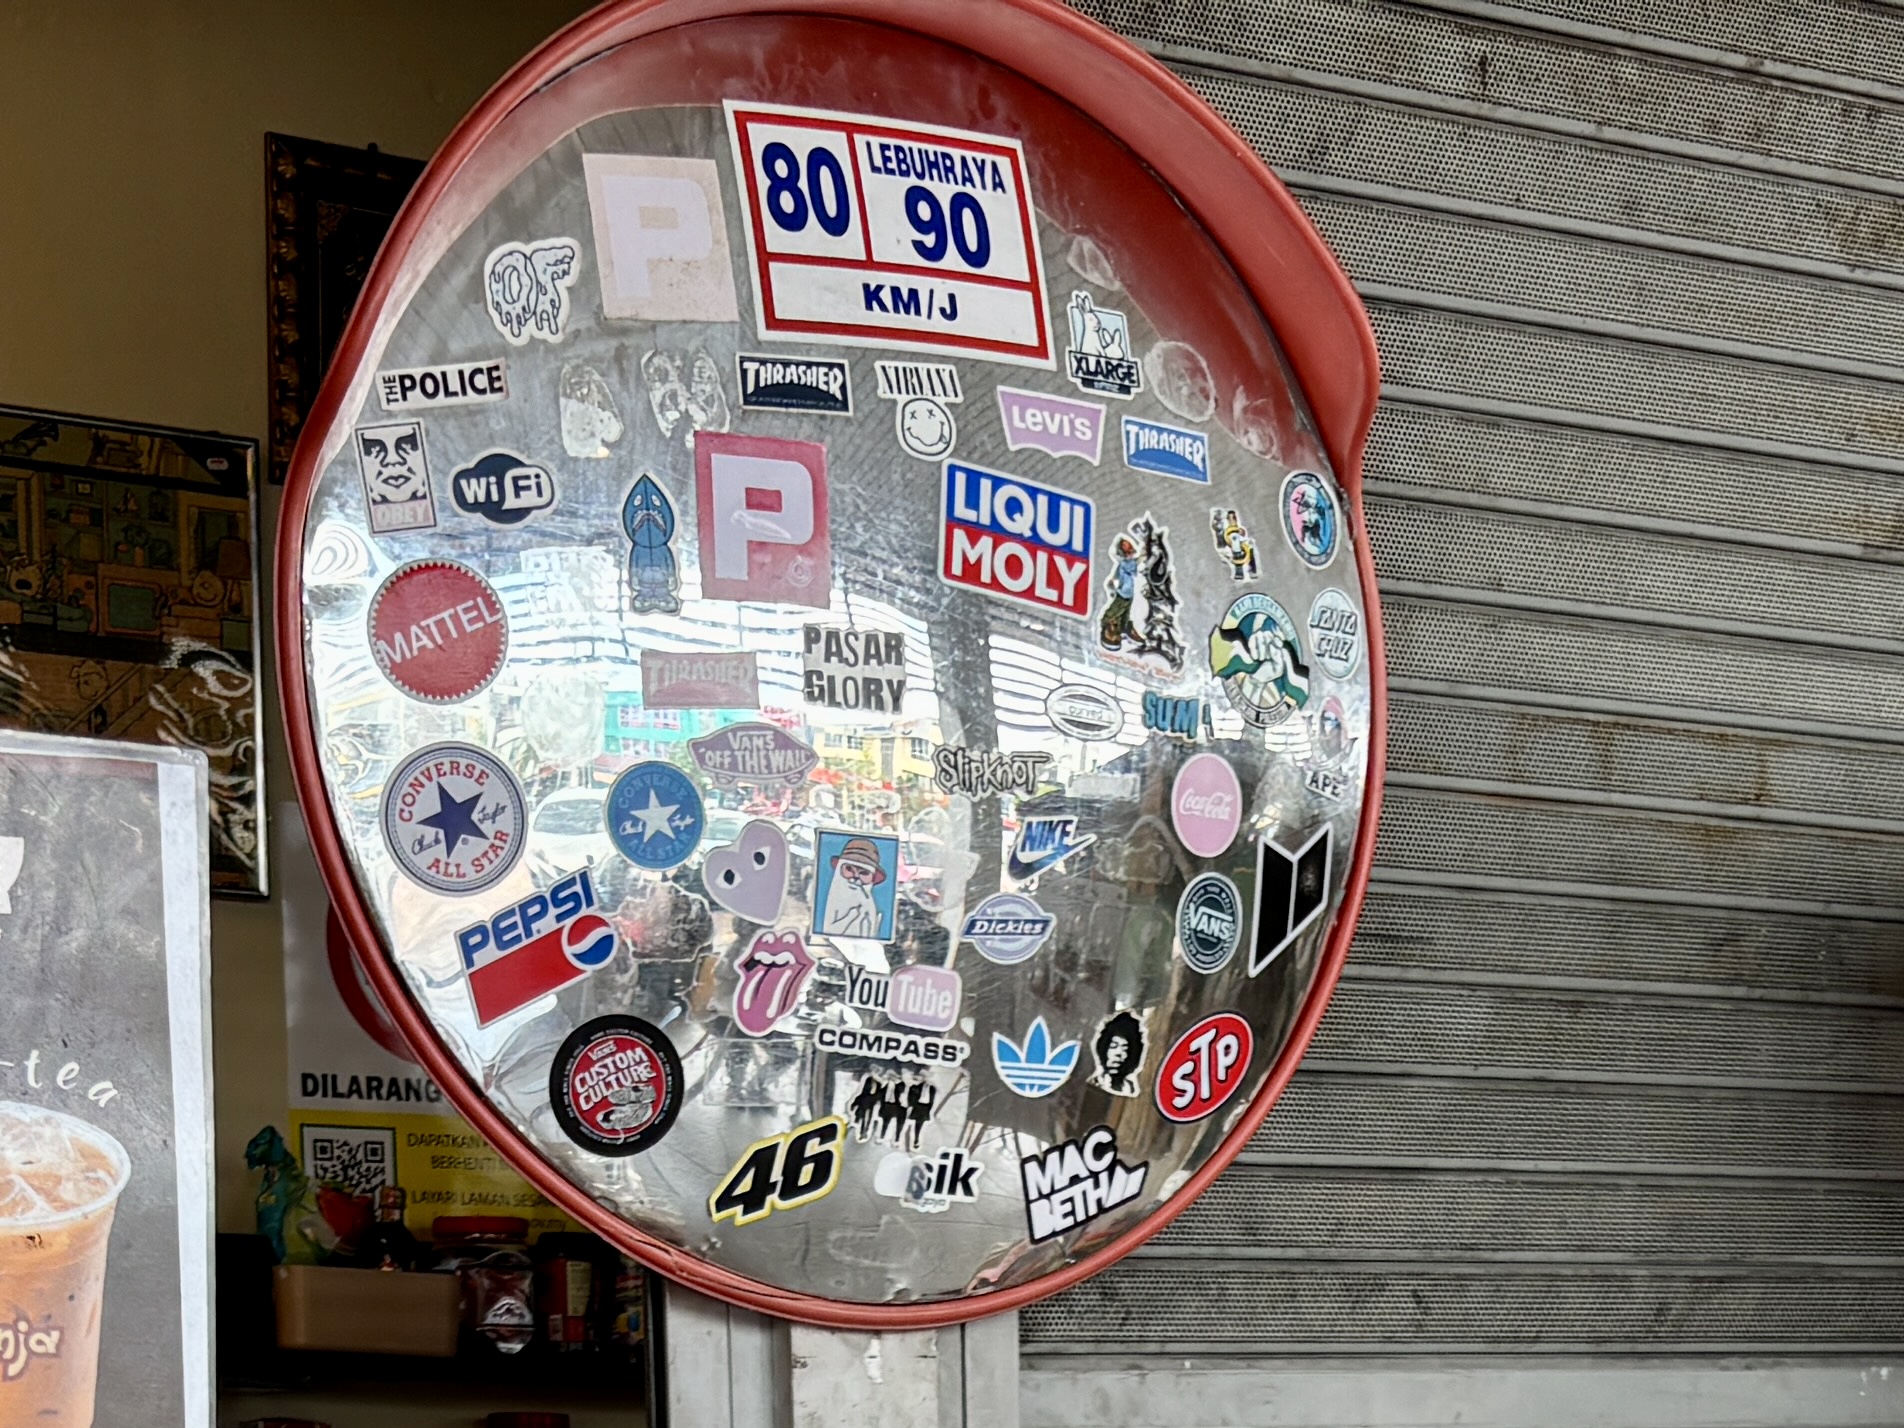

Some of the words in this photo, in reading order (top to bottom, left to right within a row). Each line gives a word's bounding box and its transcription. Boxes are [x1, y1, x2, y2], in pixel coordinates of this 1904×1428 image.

[762, 142, 850, 237] 80
[866, 140, 1006, 193] LEBUHRAYA
[601, 175, 711, 299] P
[905, 185, 991, 269] 90
[862, 282, 958, 321] KM/J
[398, 364, 504, 401] POLICE
[744, 362, 844, 399] THRASHER
[1073, 355, 1137, 383] XLARGE
[1127, 425, 1204, 471] THRASHER
[711, 453, 814, 581] P
[953, 471, 1086, 551] LIQUI
[951, 529, 1087, 606] MOLY
[377, 596, 502, 667] MATTEL
[804, 626, 905, 668] PASAR
[804, 669, 906, 713] GLORY
[399, 760, 490, 823] CONVERSE
[427, 857, 466, 879] ALL
[472, 829, 510, 874] STAR
[1021, 820, 1076, 851] NIKE
[458, 870, 594, 968] PEPSI
[1189, 902, 1236, 940] VANS
[575, 1048, 648, 1093] CUSTOM
[819, 1029, 958, 1062] COMPASS
[1173, 1029, 1239, 1108] STP
[24, 1048, 119, 1109] tea
[301, 1071, 442, 1102] DILARANG
[579, 1062, 656, 1111] CULTURE
[715, 1122, 838, 1217] 46
[1024, 1130, 1115, 1200] MAC
